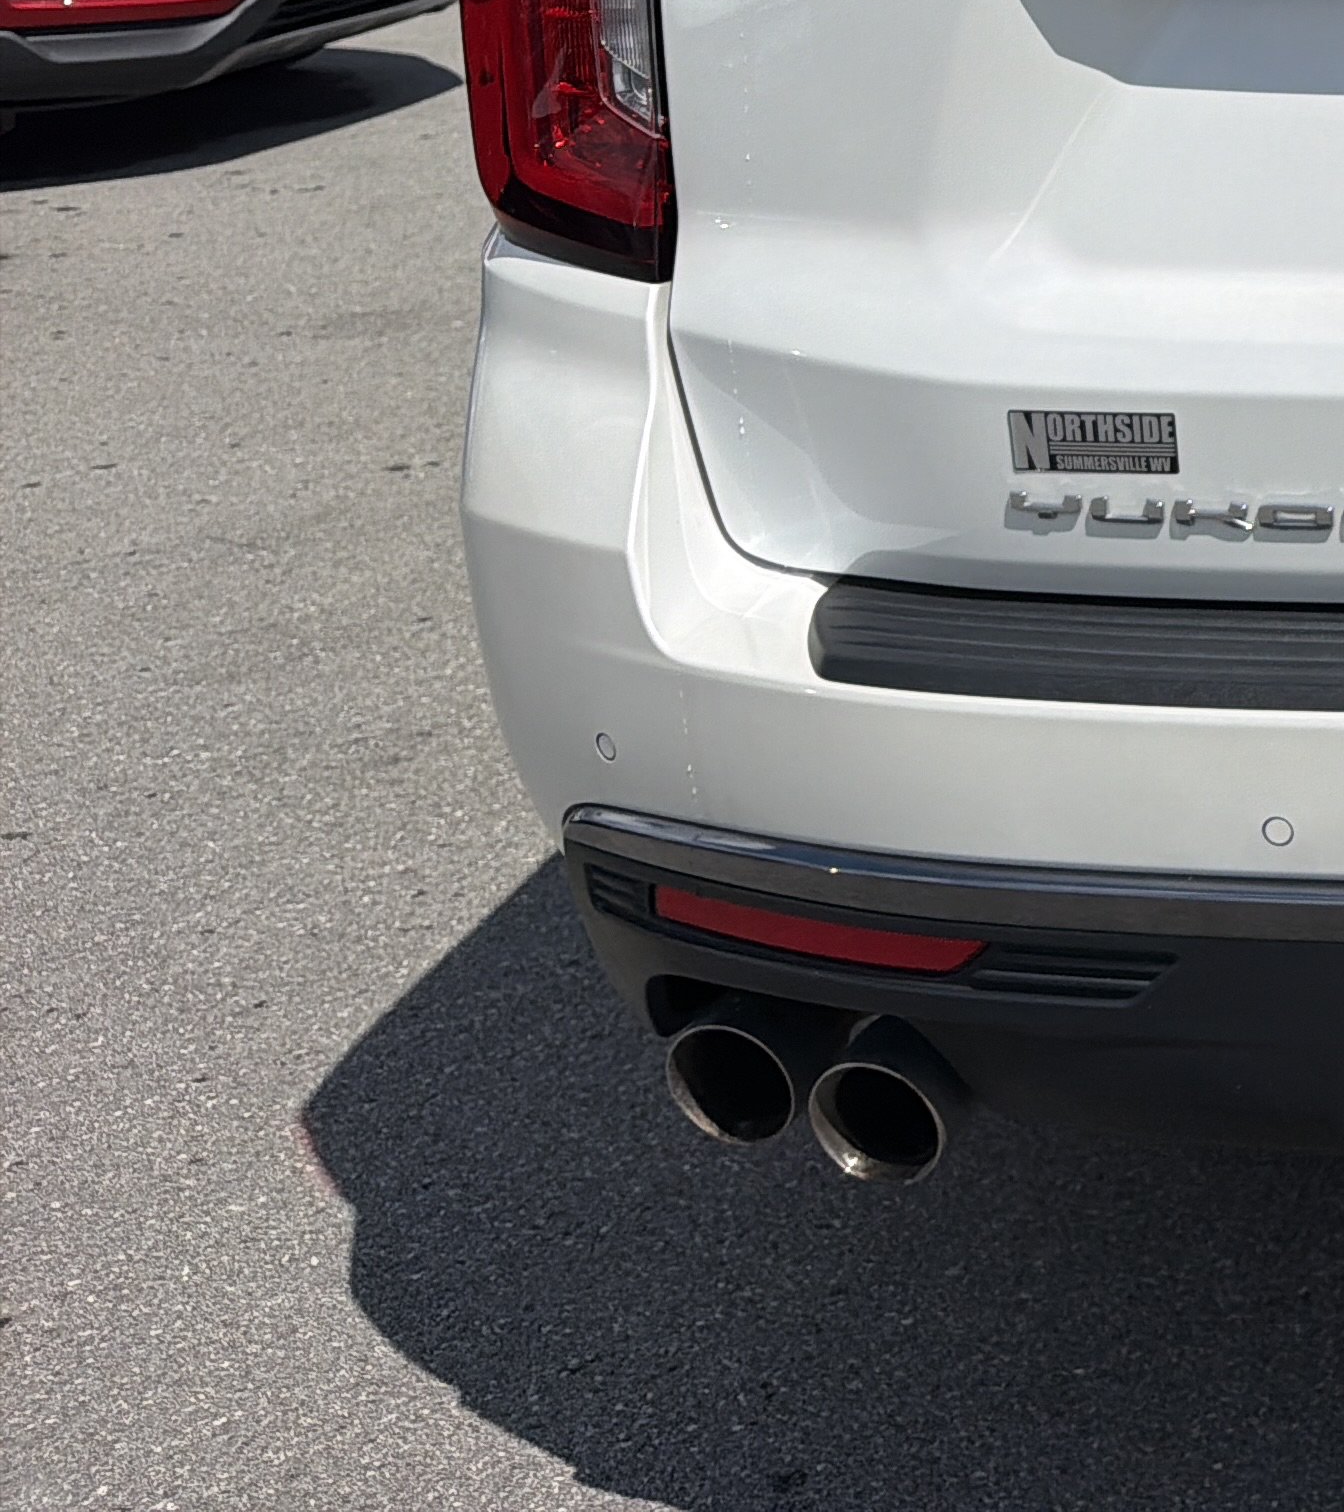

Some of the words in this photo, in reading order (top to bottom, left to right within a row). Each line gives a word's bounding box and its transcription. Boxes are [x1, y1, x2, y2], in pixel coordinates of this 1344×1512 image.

[1009, 411, 1176, 470] NORTHSIDE
[1055, 455, 1149, 472] SUMMERSVILLE
[1150, 457, 1172, 472] WV
